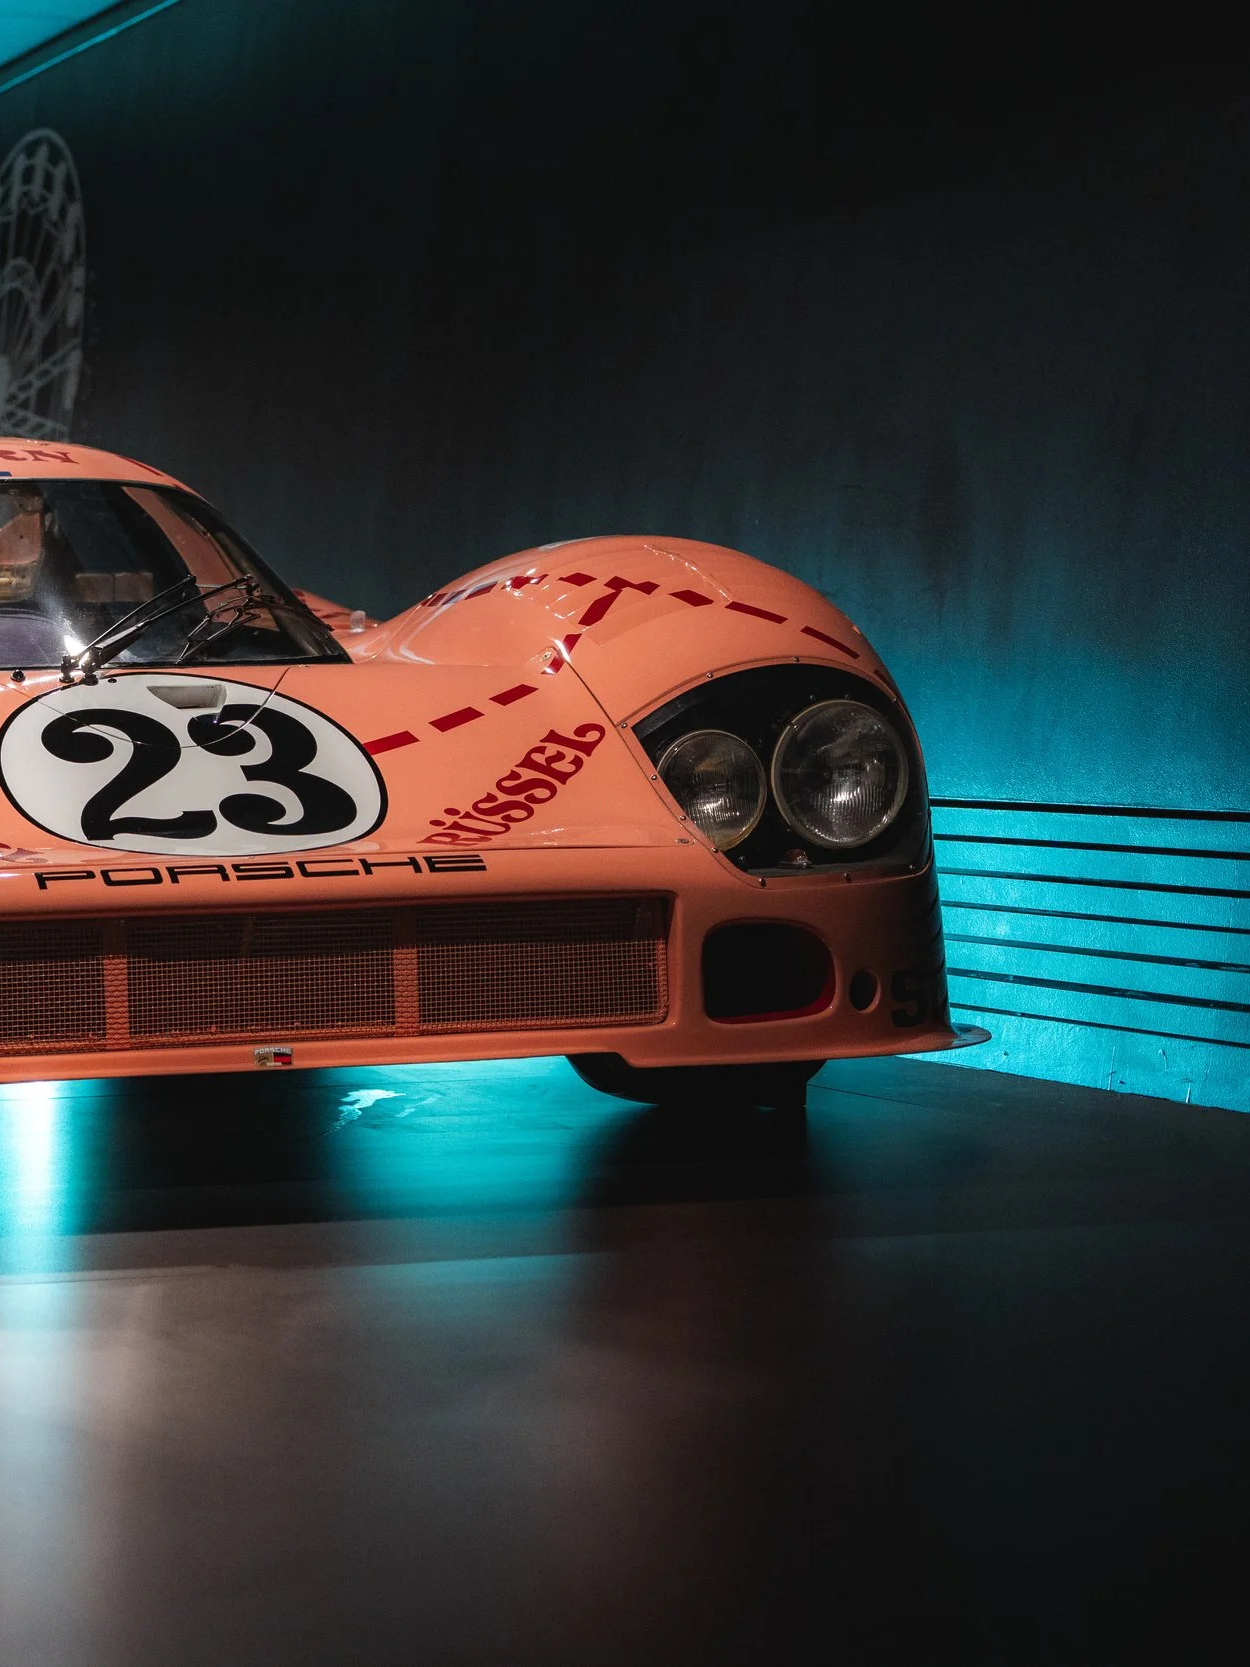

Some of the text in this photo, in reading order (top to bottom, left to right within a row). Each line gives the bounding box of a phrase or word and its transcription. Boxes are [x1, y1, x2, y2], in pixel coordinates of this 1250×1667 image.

[40, 703, 358, 841] 23
[416, 722, 607, 847] RÜSSEL
[34, 853, 488, 891] PORSCHE
